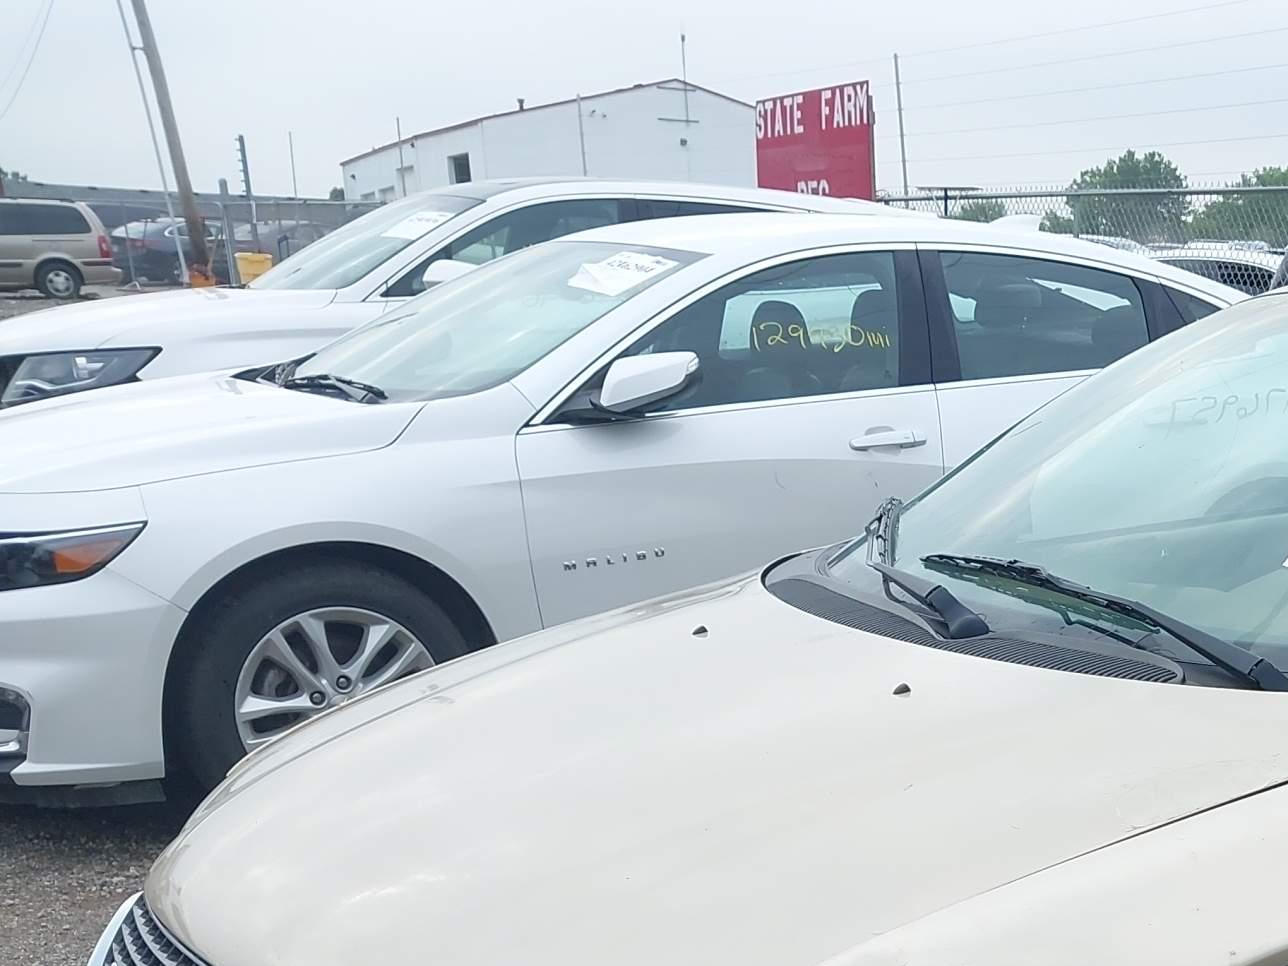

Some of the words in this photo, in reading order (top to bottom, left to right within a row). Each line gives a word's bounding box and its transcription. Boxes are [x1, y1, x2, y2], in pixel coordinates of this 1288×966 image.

[756, 95, 804, 140] STATE
[820, 82, 868, 130] FARM
[563, 547, 665, 571] MALIBU
